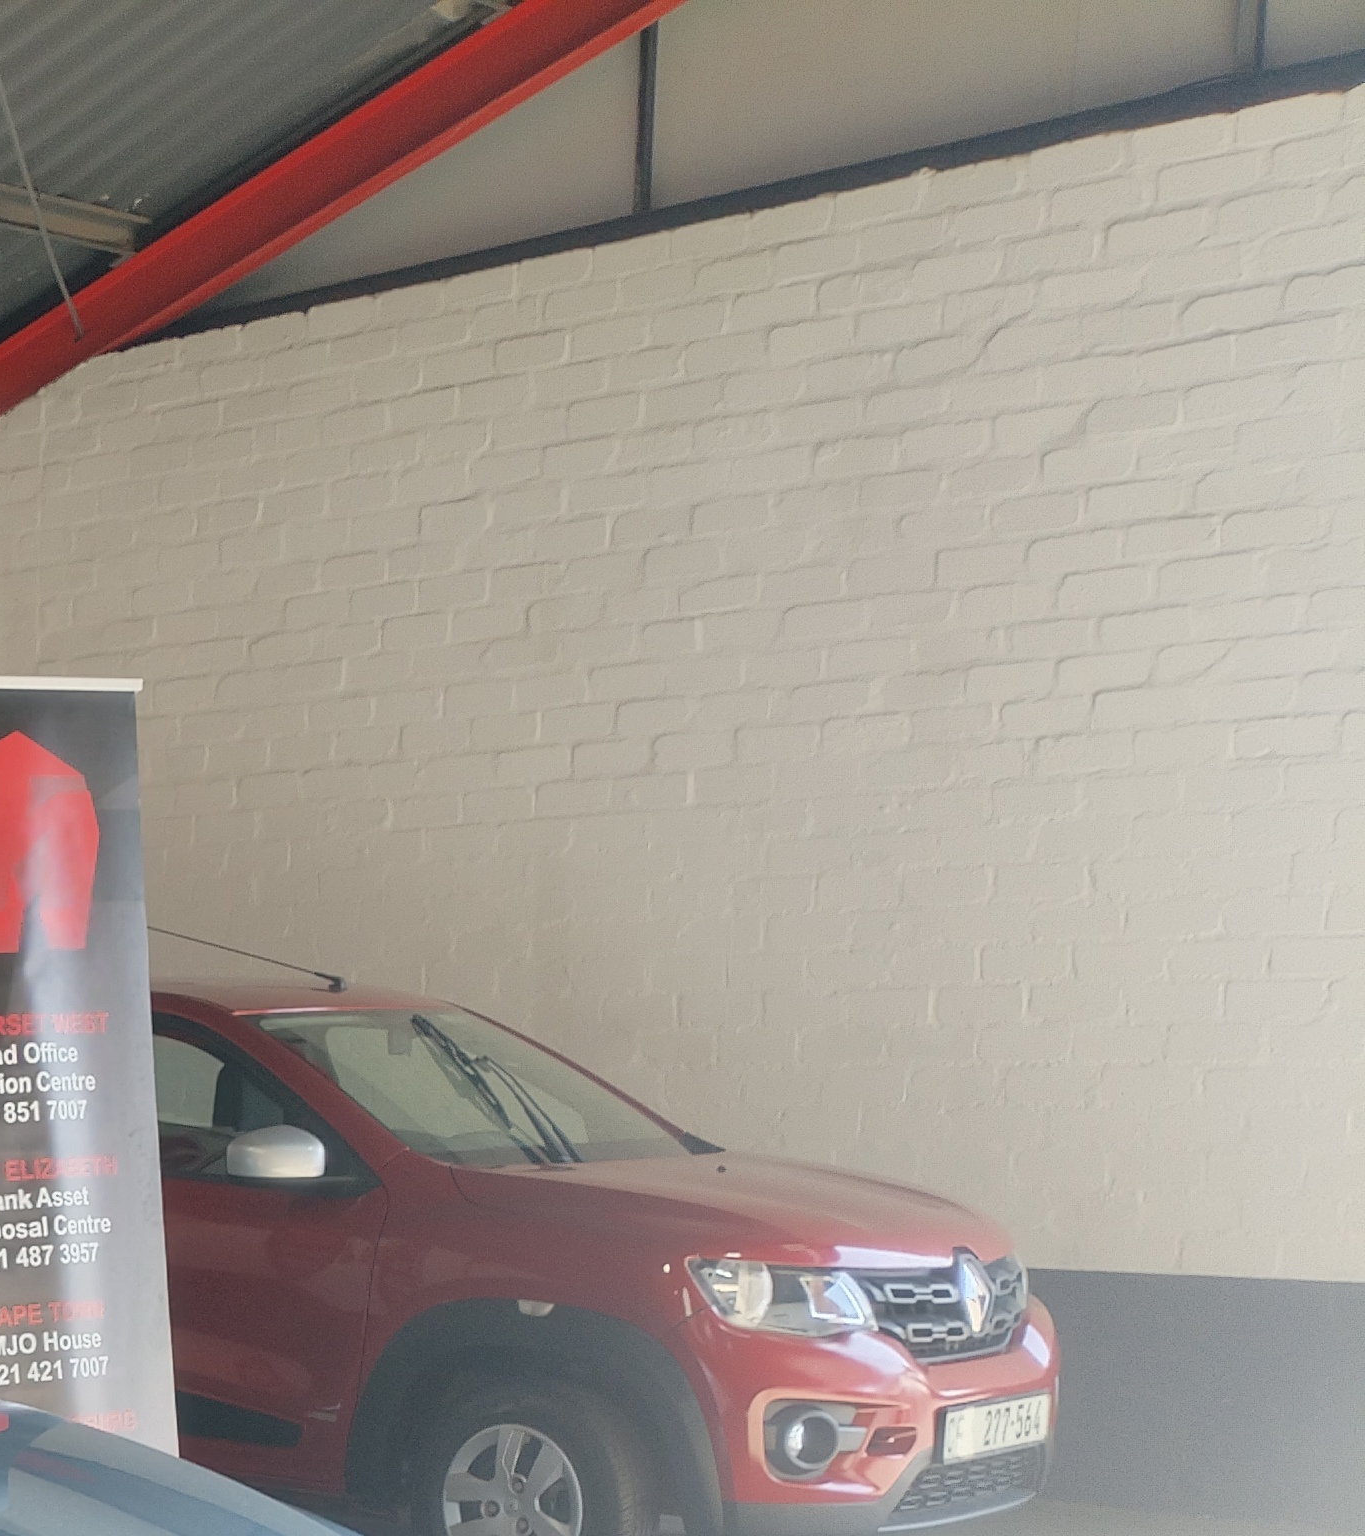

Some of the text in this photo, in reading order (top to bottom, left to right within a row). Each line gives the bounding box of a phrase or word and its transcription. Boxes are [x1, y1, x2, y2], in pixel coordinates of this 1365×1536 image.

[52, 1011, 110, 1034] WEST
[23, 1041, 79, 1064] Office
[36, 1070, 96, 1092] Centre
[3, 1101, 40, 1124] 851
[46, 1099, 87, 1121] 7007
[5, 1155, 118, 1182] ELIZABETH
[35, 1186, 90, 1208] Asset
[53, 1214, 112, 1236] Centre
[16, 1245, 54, 1268] 487
[60, 1242, 99, 1264] 3957
[43, 1330, 102, 1352] House
[27, 1360, 64, 1382] 421
[69, 1355, 109, 1378] 7007
